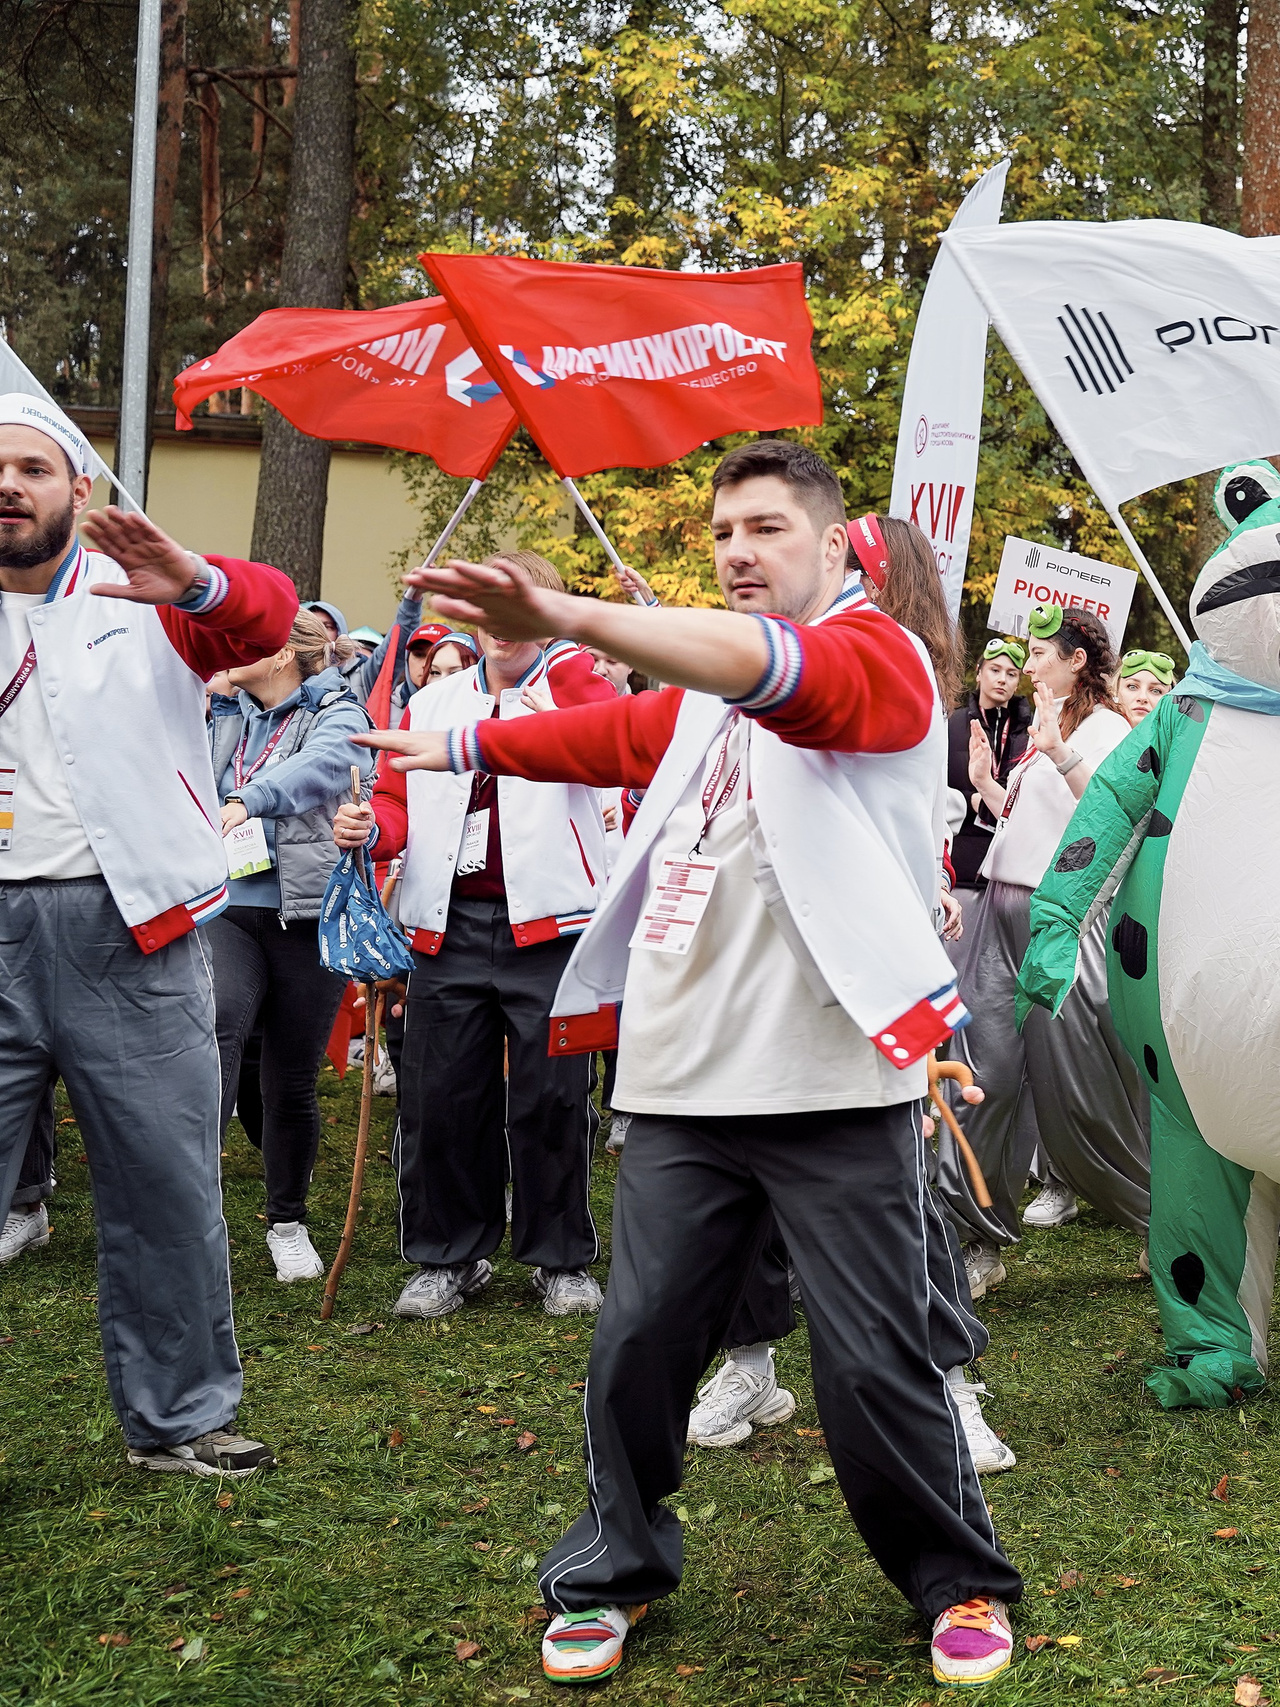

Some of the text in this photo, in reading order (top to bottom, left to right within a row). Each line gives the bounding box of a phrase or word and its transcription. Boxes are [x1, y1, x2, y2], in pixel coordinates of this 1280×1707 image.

[1046, 562, 1112, 587] PIONEER
[1013, 578, 1111, 621] PIONEER
[5, 667, 30, 704] ФУНДАМЕНТ
[234, 828, 254, 840] XVIII
[466, 823, 482, 835] XVIII
